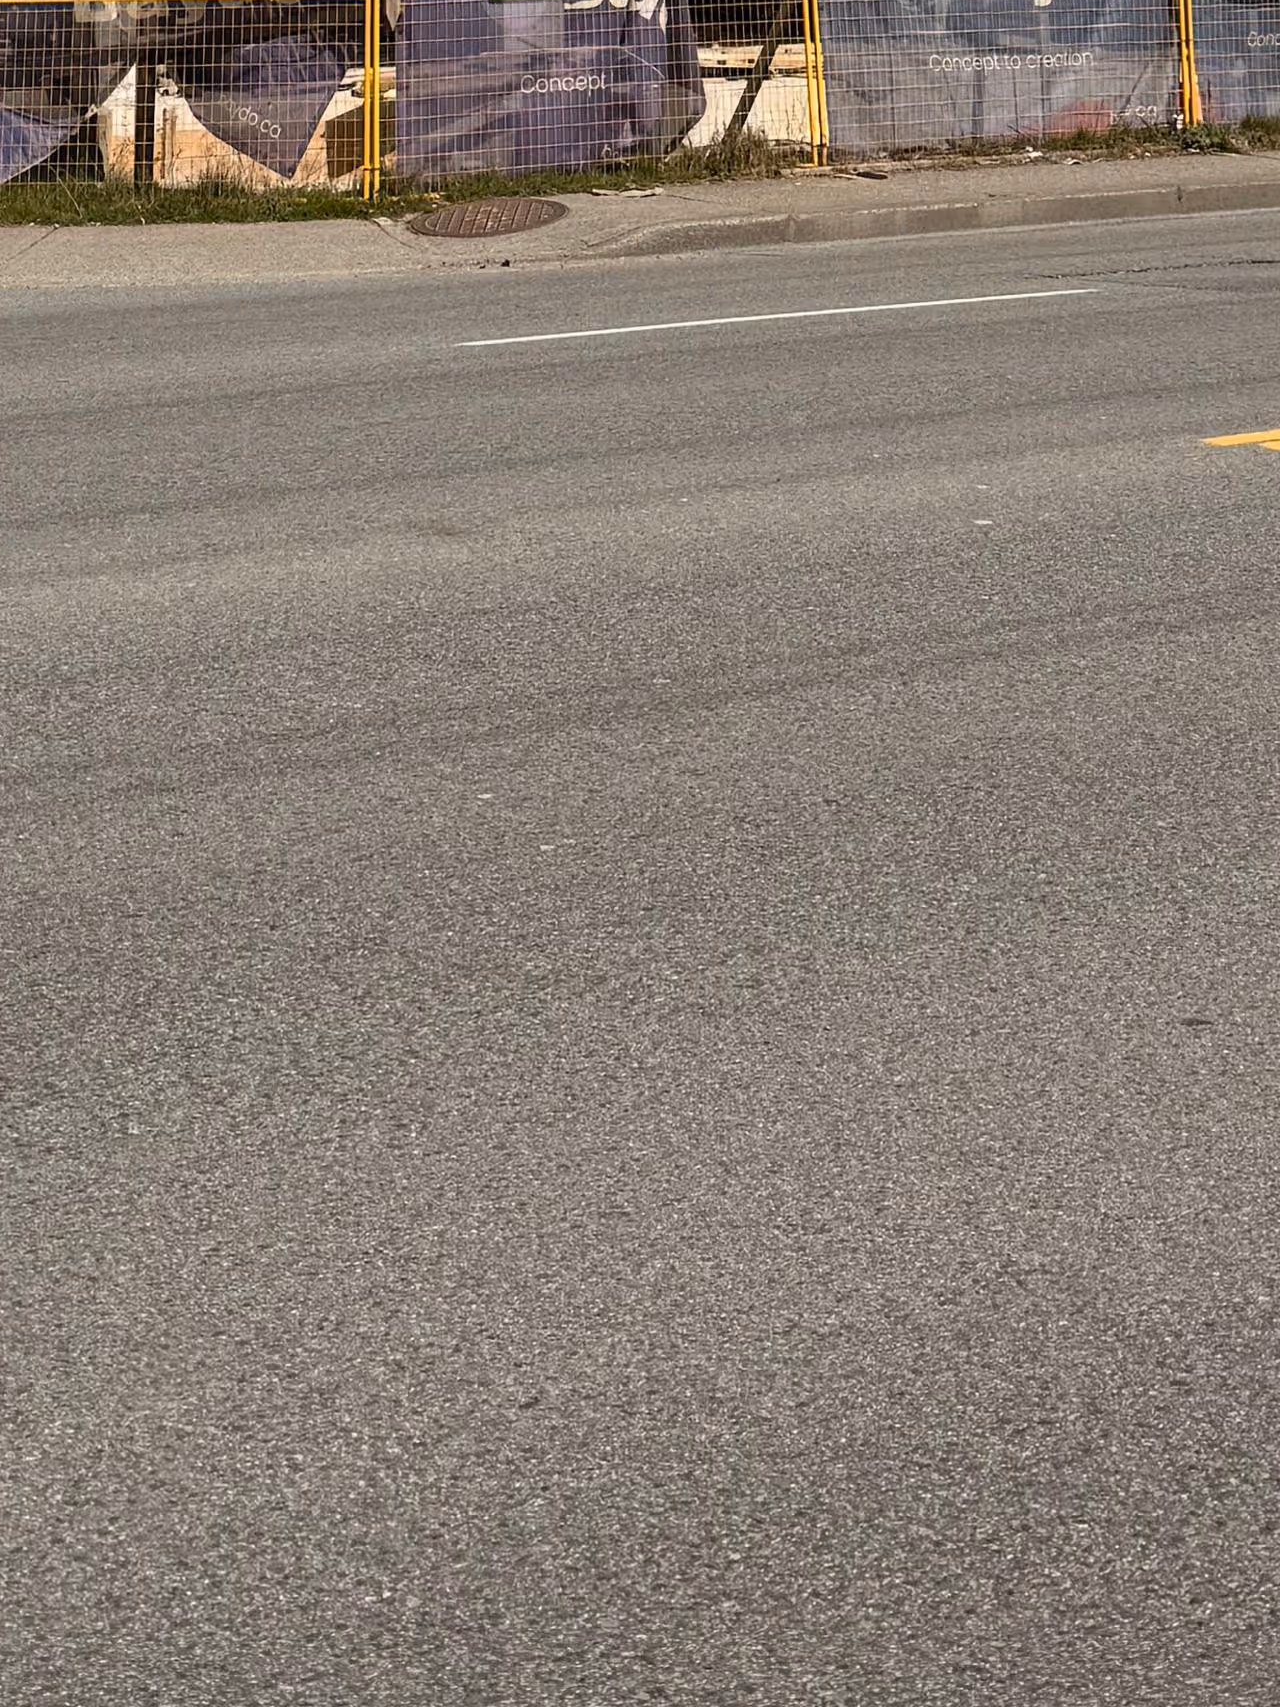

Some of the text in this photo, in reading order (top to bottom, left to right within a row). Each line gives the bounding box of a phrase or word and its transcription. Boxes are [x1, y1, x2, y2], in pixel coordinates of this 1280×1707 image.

[929, 53, 1000, 76] Concept
[1004, 53, 1021, 70] to
[520, 73, 606, 98] Concept
